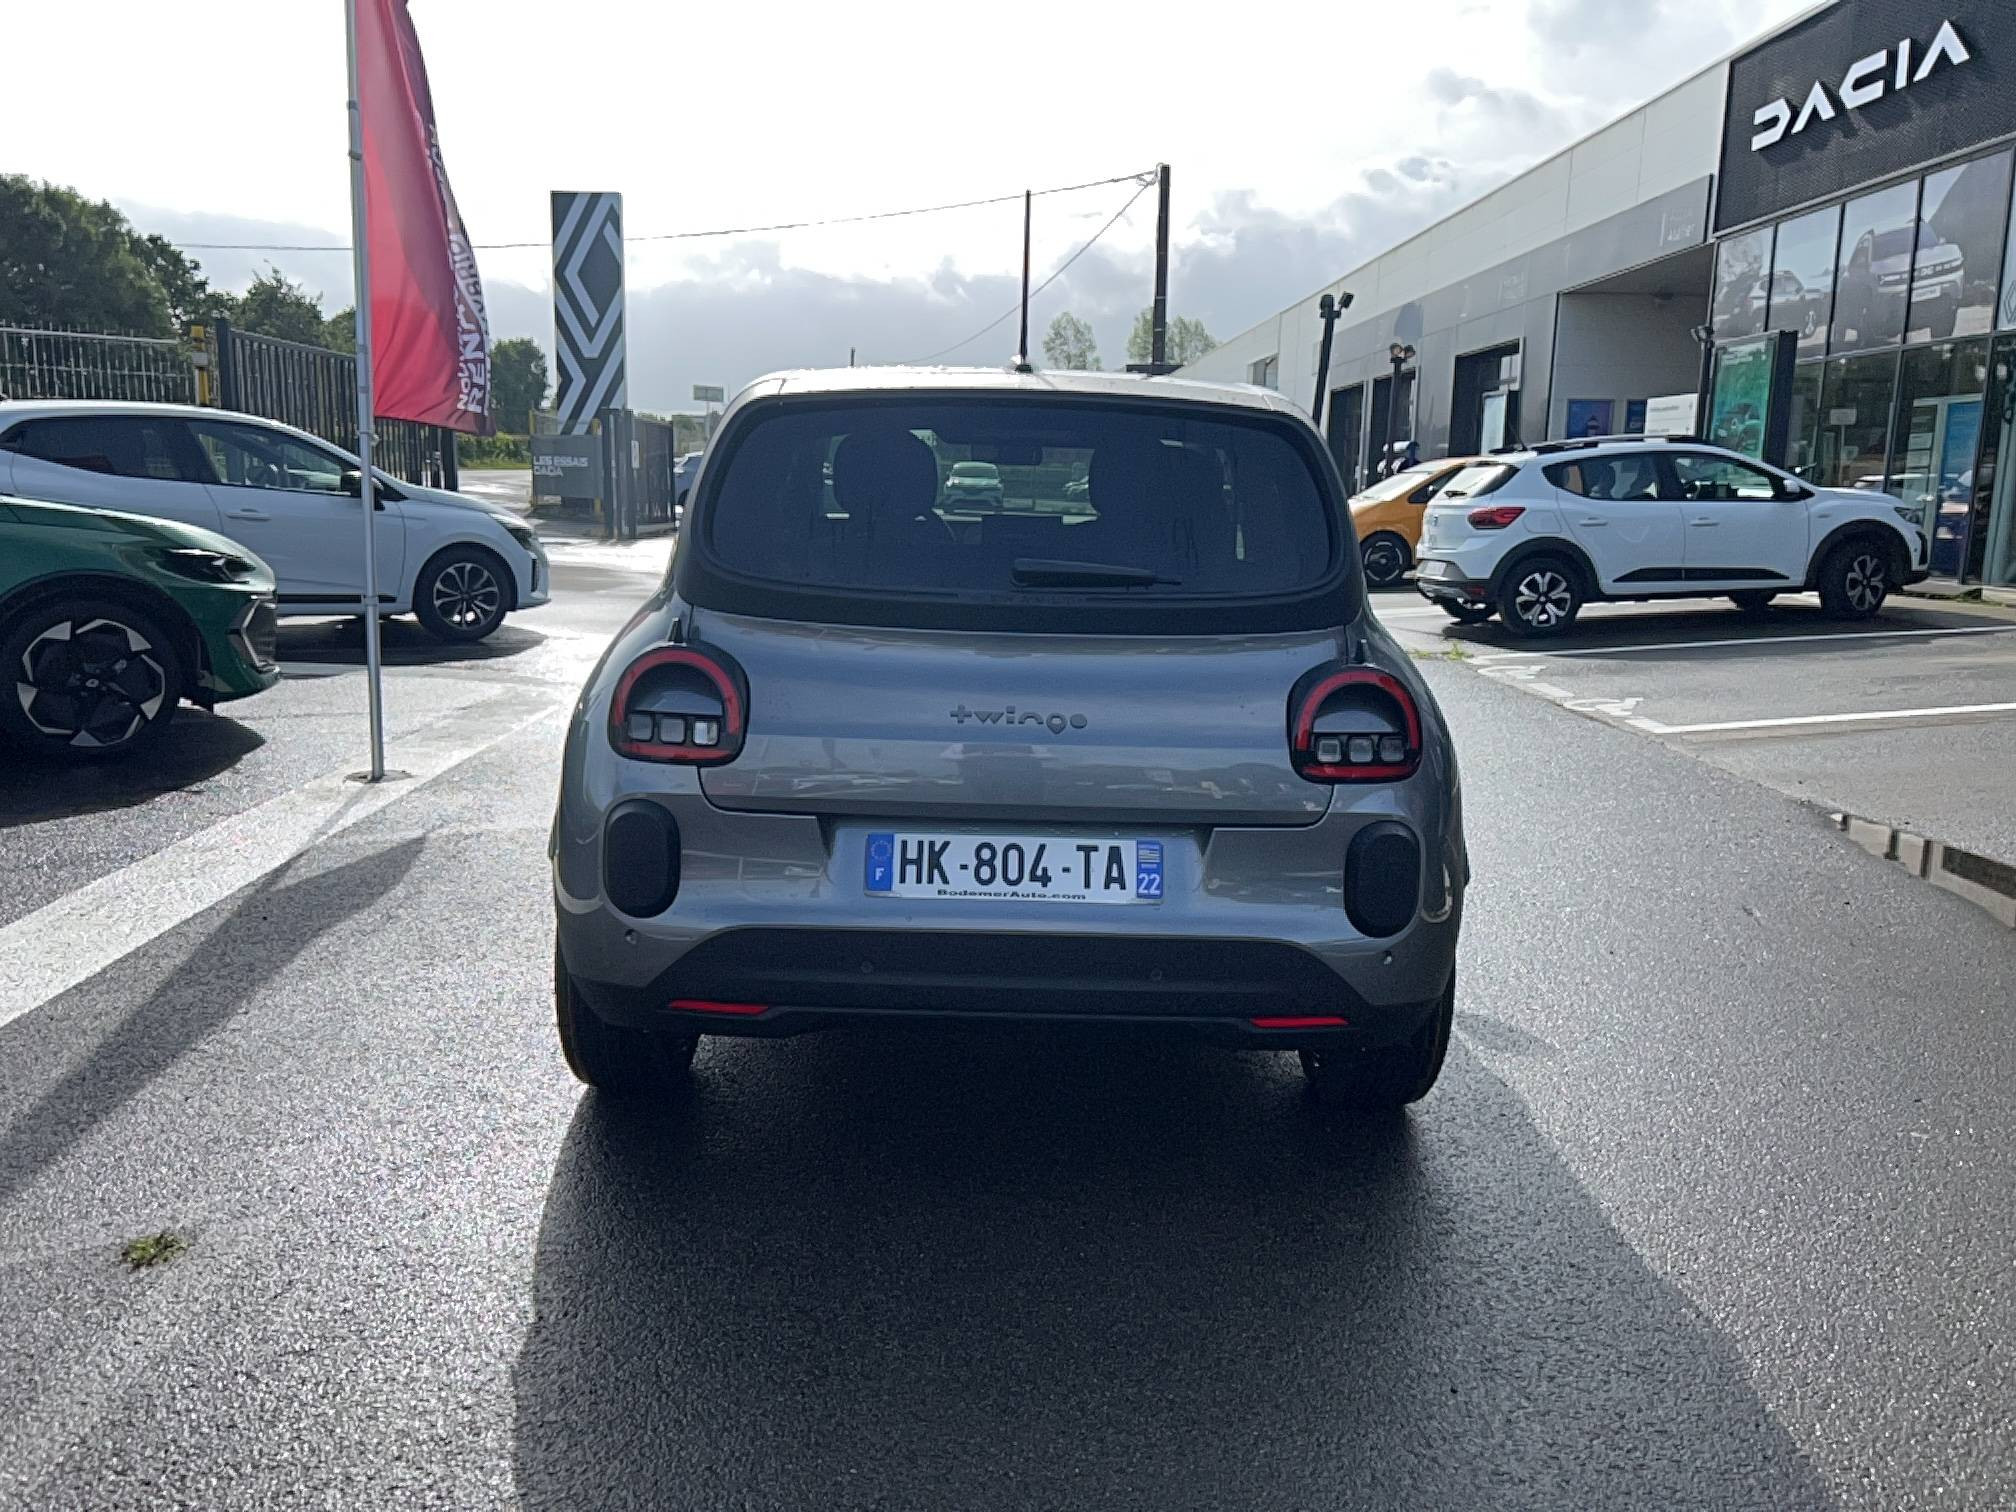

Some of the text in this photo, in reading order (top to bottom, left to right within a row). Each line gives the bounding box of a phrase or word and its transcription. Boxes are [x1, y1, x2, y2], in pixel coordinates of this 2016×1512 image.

[1751, 19, 1970, 152] DACIA
[950, 704, 1087, 734] twingo
[875, 867, 885, 881] F
[899, 839, 1127, 891] HK-804-TA
[1138, 872, 1161, 894] 22
